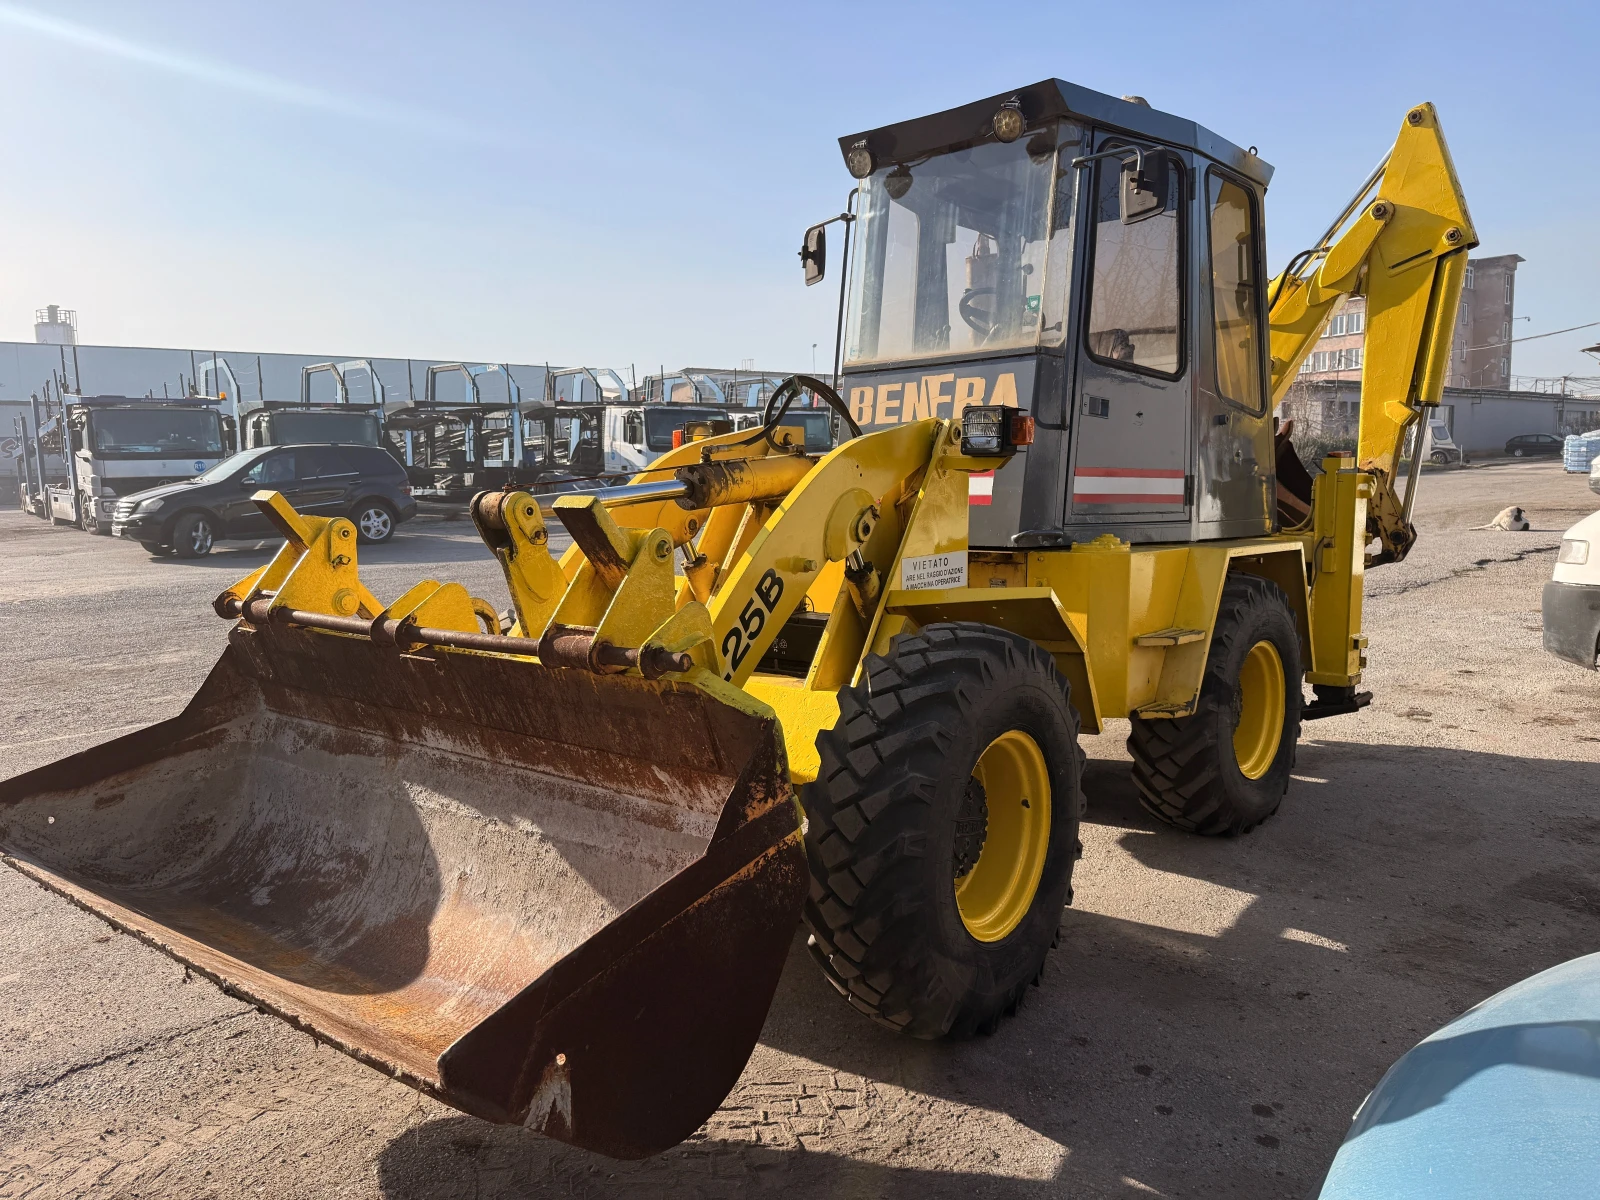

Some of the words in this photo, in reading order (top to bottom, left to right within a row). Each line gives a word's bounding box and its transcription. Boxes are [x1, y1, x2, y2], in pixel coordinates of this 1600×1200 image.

[849, 372, 1019, 426] BENFRA
[912, 558, 948, 570] VIETATO
[916, 573, 926, 581] NEL
[926, 569, 943, 579] RAGGIO
[943, 566, 964, 576] D'AZIONE
[934, 575, 961, 587] OPERATRICE
